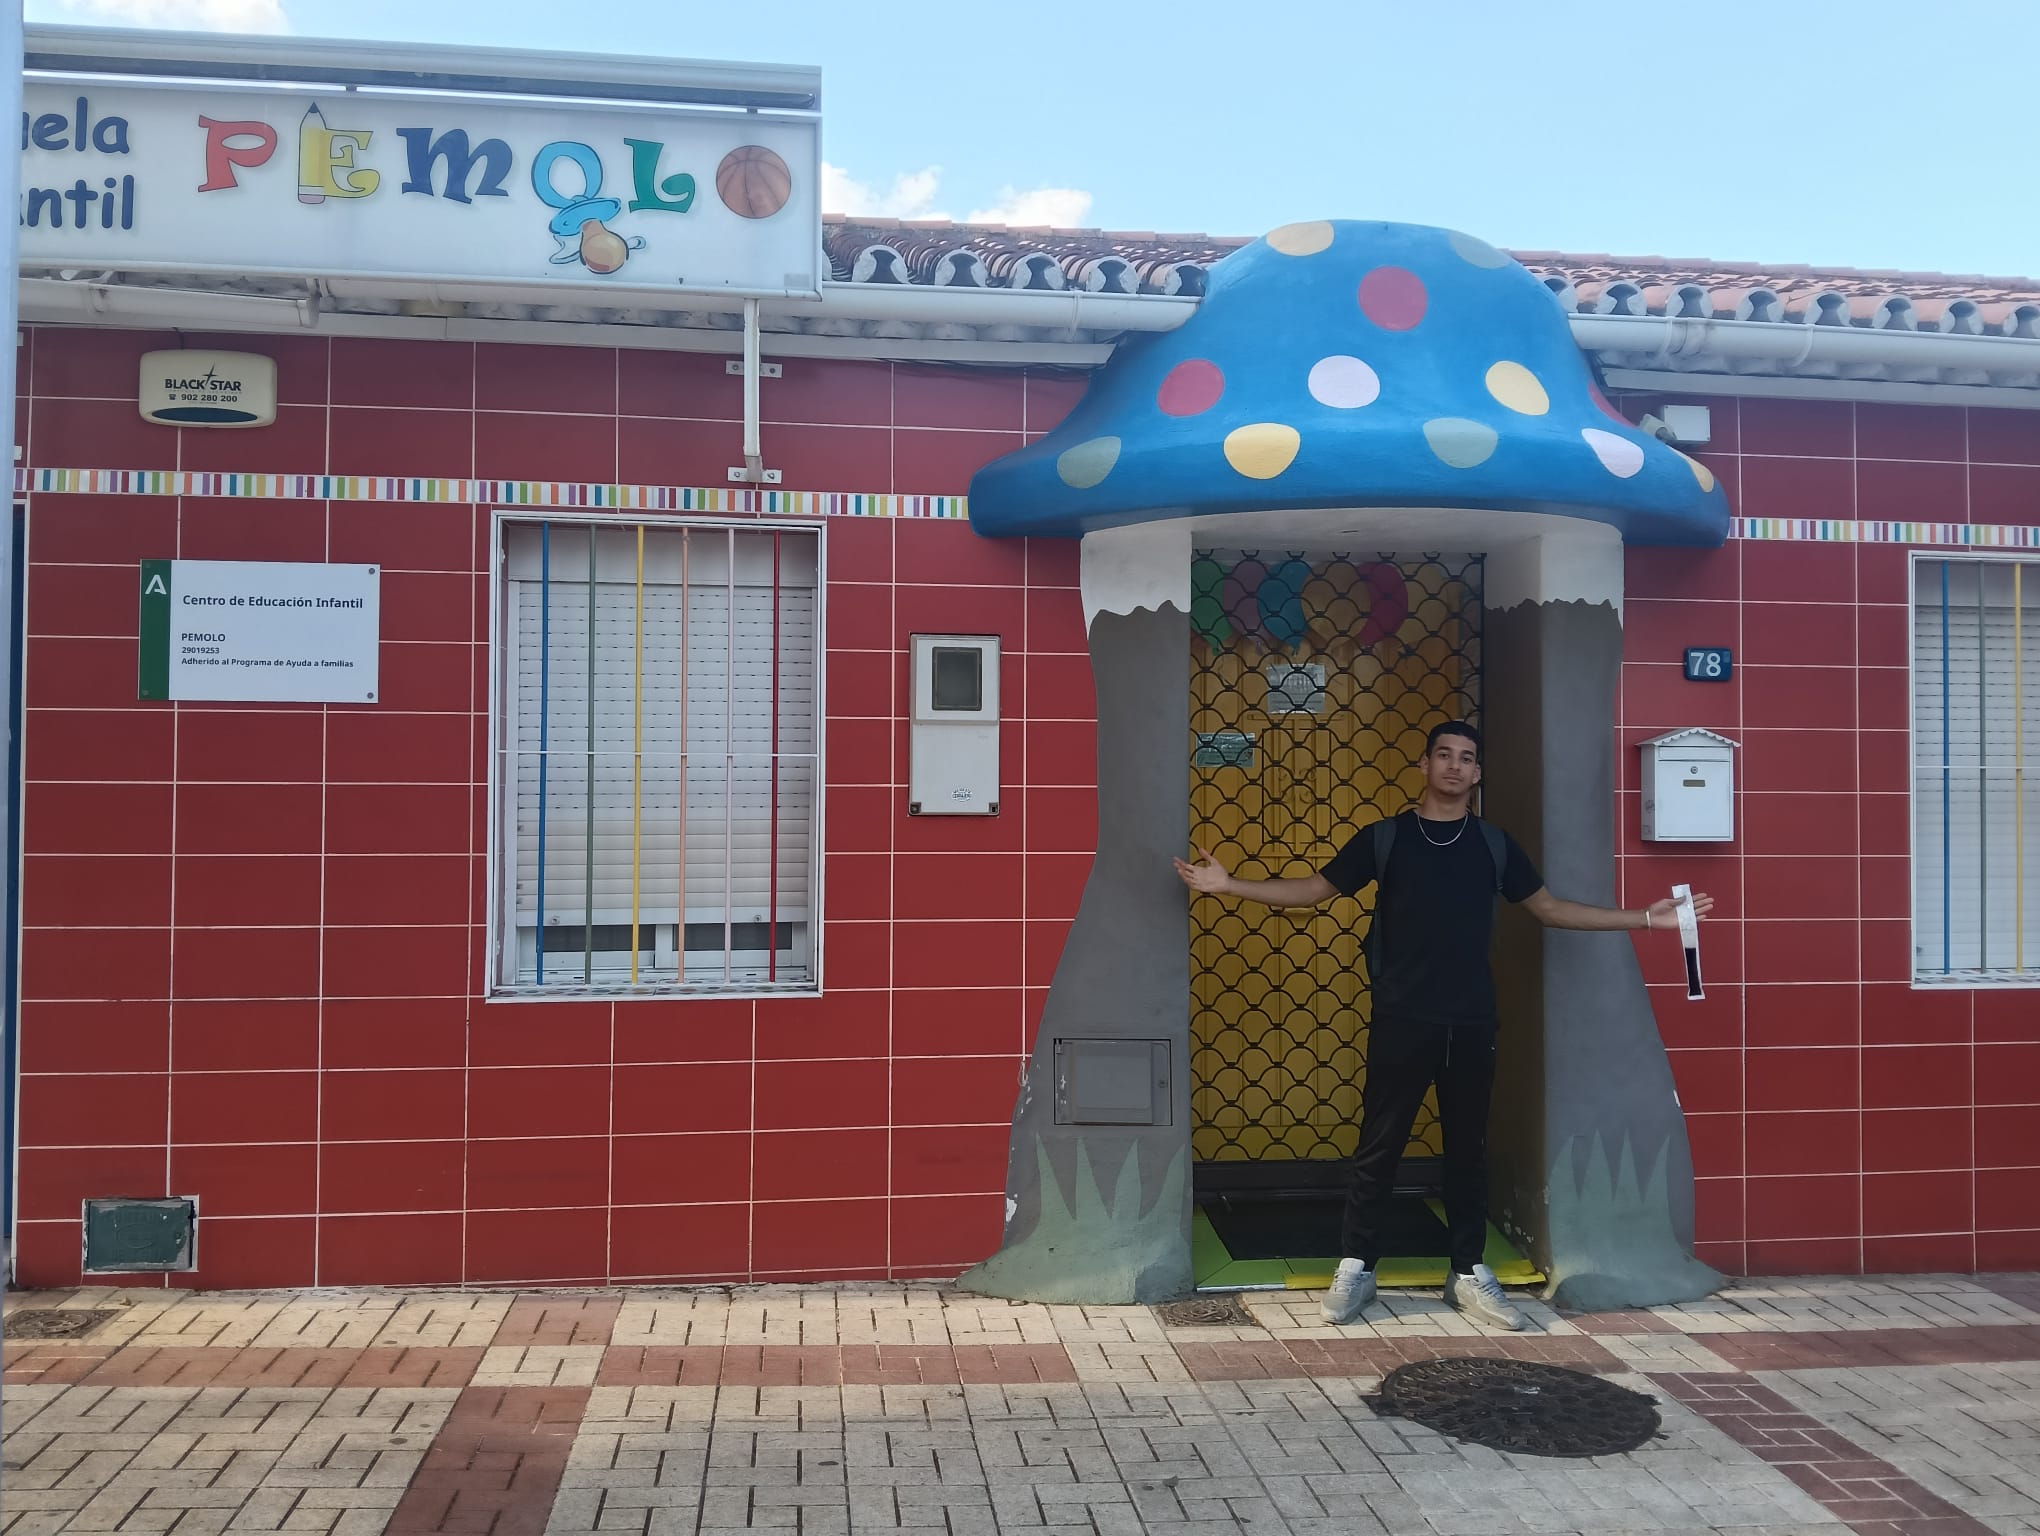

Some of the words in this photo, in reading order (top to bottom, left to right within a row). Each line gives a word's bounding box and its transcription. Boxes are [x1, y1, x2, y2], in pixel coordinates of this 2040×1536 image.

[22, 97, 130, 154] ela
[20, 175, 134, 230] ntil
[165, 378, 205, 390] BLACK
[210, 380, 242, 391] STAR
[181, 393, 198, 401] 902
[200, 394, 218, 402] 280
[182, 595, 226, 606] Centro
[229, 595, 245, 606] de
[248, 596, 313, 608] Educación
[316, 597, 363, 609] Infantil
[181, 633, 226, 642] PEMOLO
[181, 646, 220, 654] 29019253
[181, 658, 220, 666] Adherido
[221, 658, 229, 666] al
[231, 658, 272, 668] Programa
[273, 659, 284, 667] de
[285, 659, 312, 668] Ayuda
[320, 659, 354, 668] familias
[1690, 652, 1722, 677] 78
